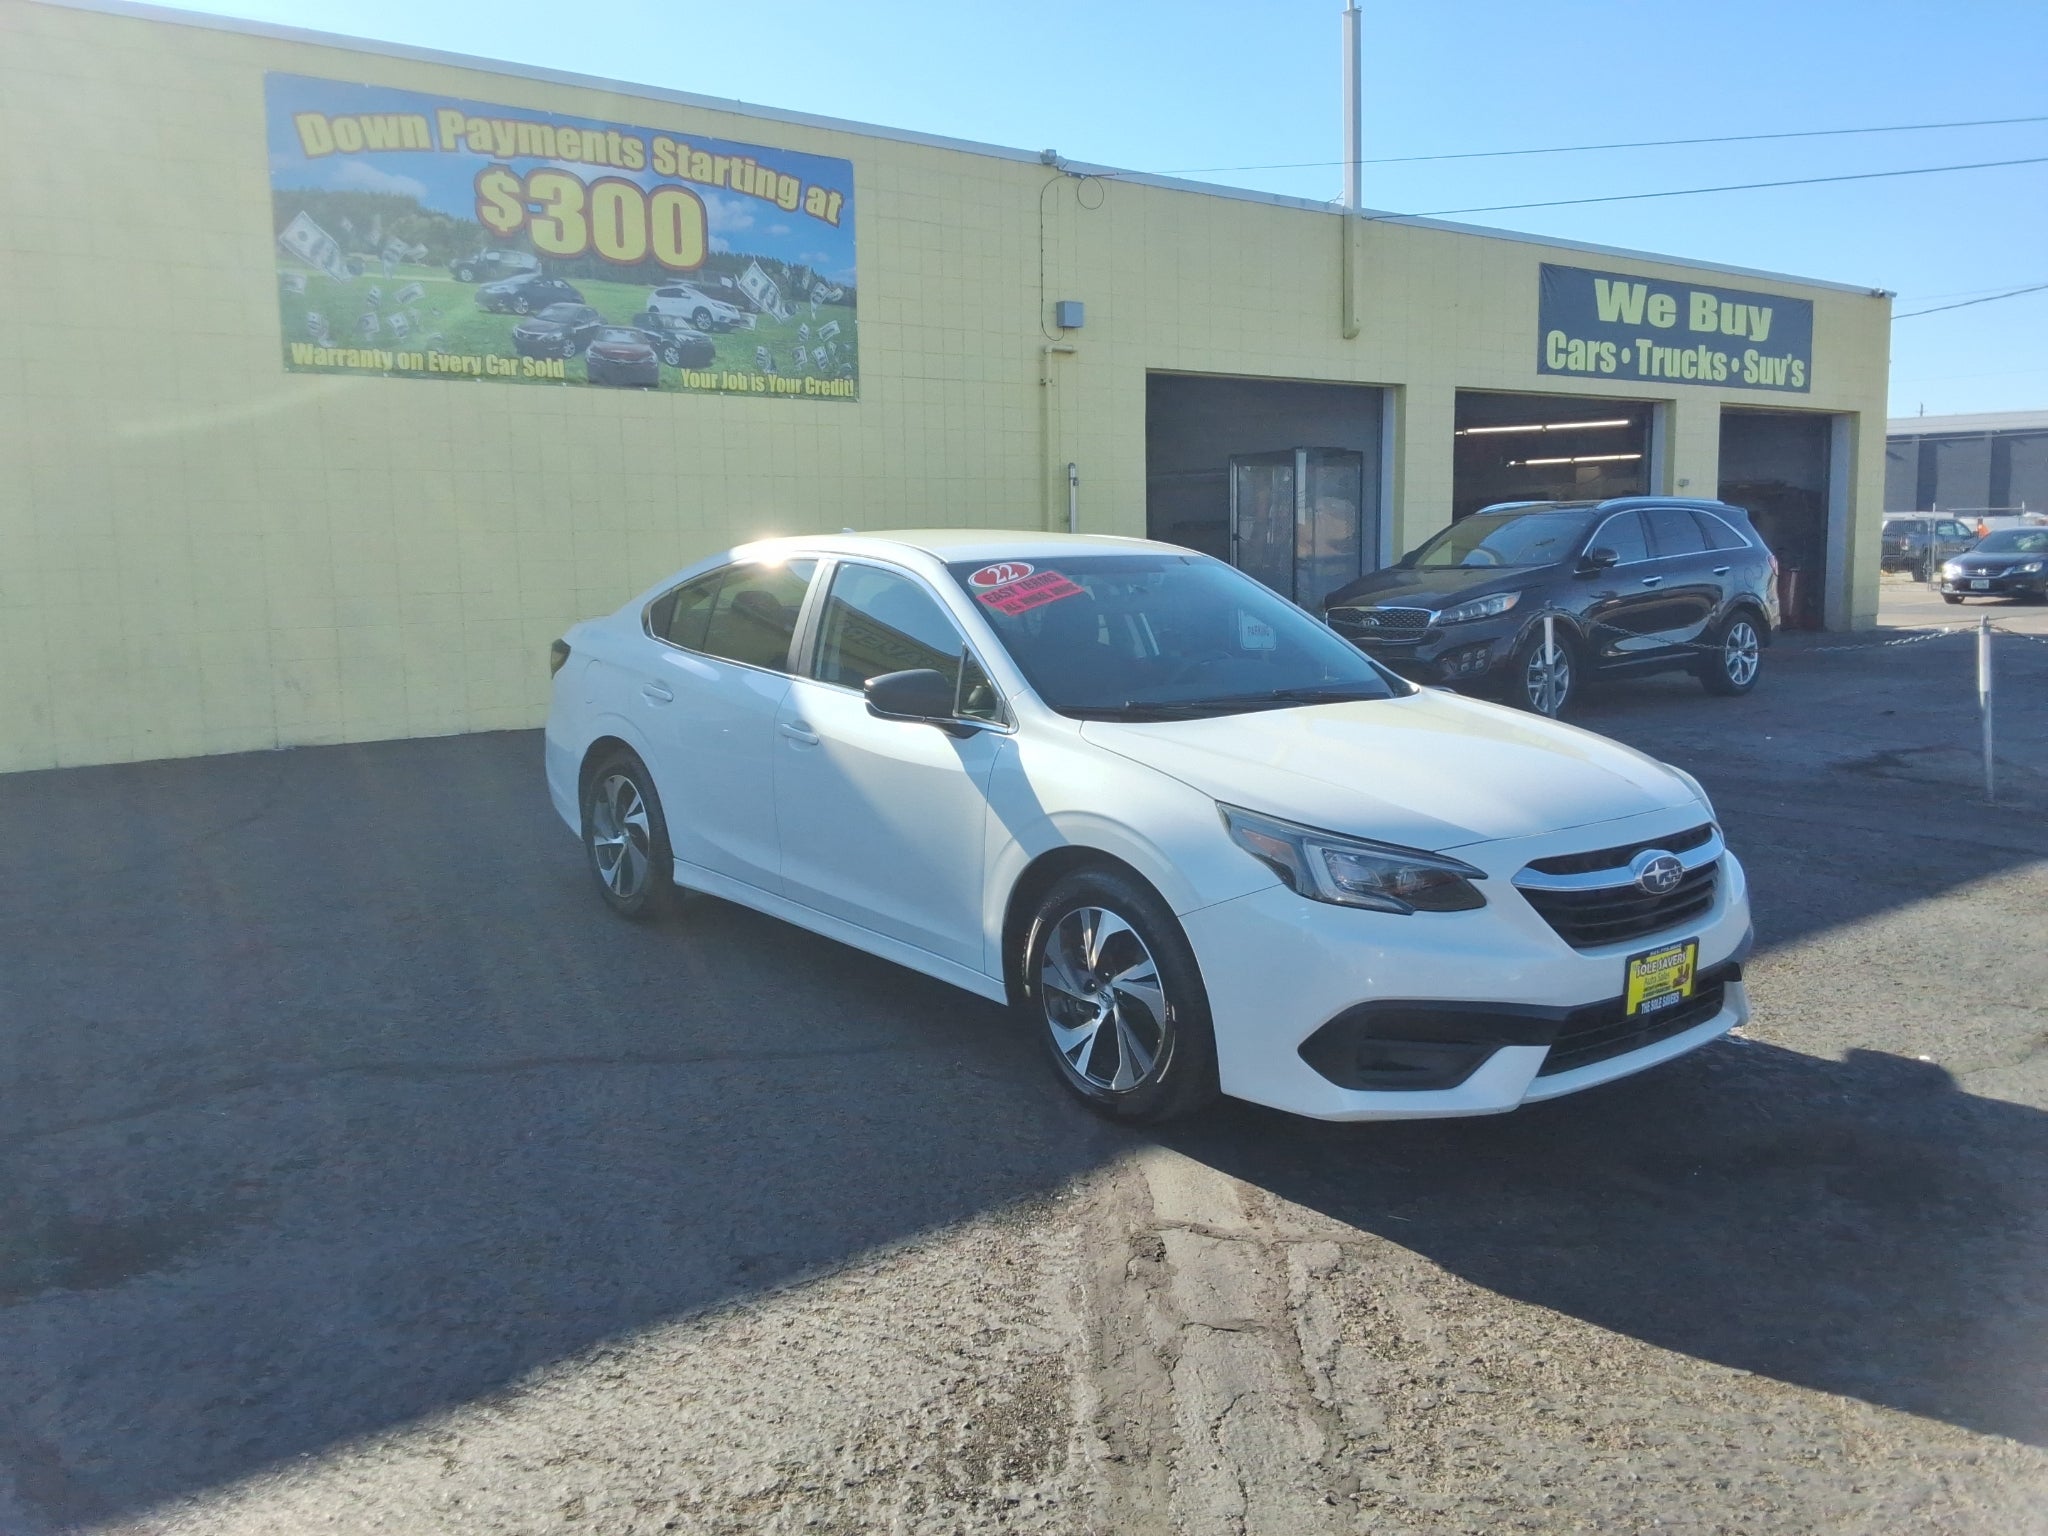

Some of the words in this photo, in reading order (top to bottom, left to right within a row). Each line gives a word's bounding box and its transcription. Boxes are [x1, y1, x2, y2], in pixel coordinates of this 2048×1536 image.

[295, 111, 432, 158] Down
[437, 108, 645, 170] Payments
[652, 137, 800, 211] Starting
[803, 184, 844, 227] at
[475, 163, 708, 270] $300
[1594, 278, 1677, 328] We
[1689, 291, 1772, 342] Buy
[291, 343, 393, 371] Warranty
[398, 352, 424, 371] on
[429, 351, 482, 376] Every
[486, 354, 520, 376] Car
[522, 357, 565, 378] Sold
[1546, 330, 1617, 374] Cars
[681, 368, 718, 388] Your
[721, 371, 748, 391] Job
[751, 373, 765, 391] is
[768, 374, 801, 394] Your
[805, 376, 854, 397] Credit!
[984, 582, 1018, 603] EASY
[1017, 572, 1062, 591] TERMS
[987, 564, 1019, 584] 22
